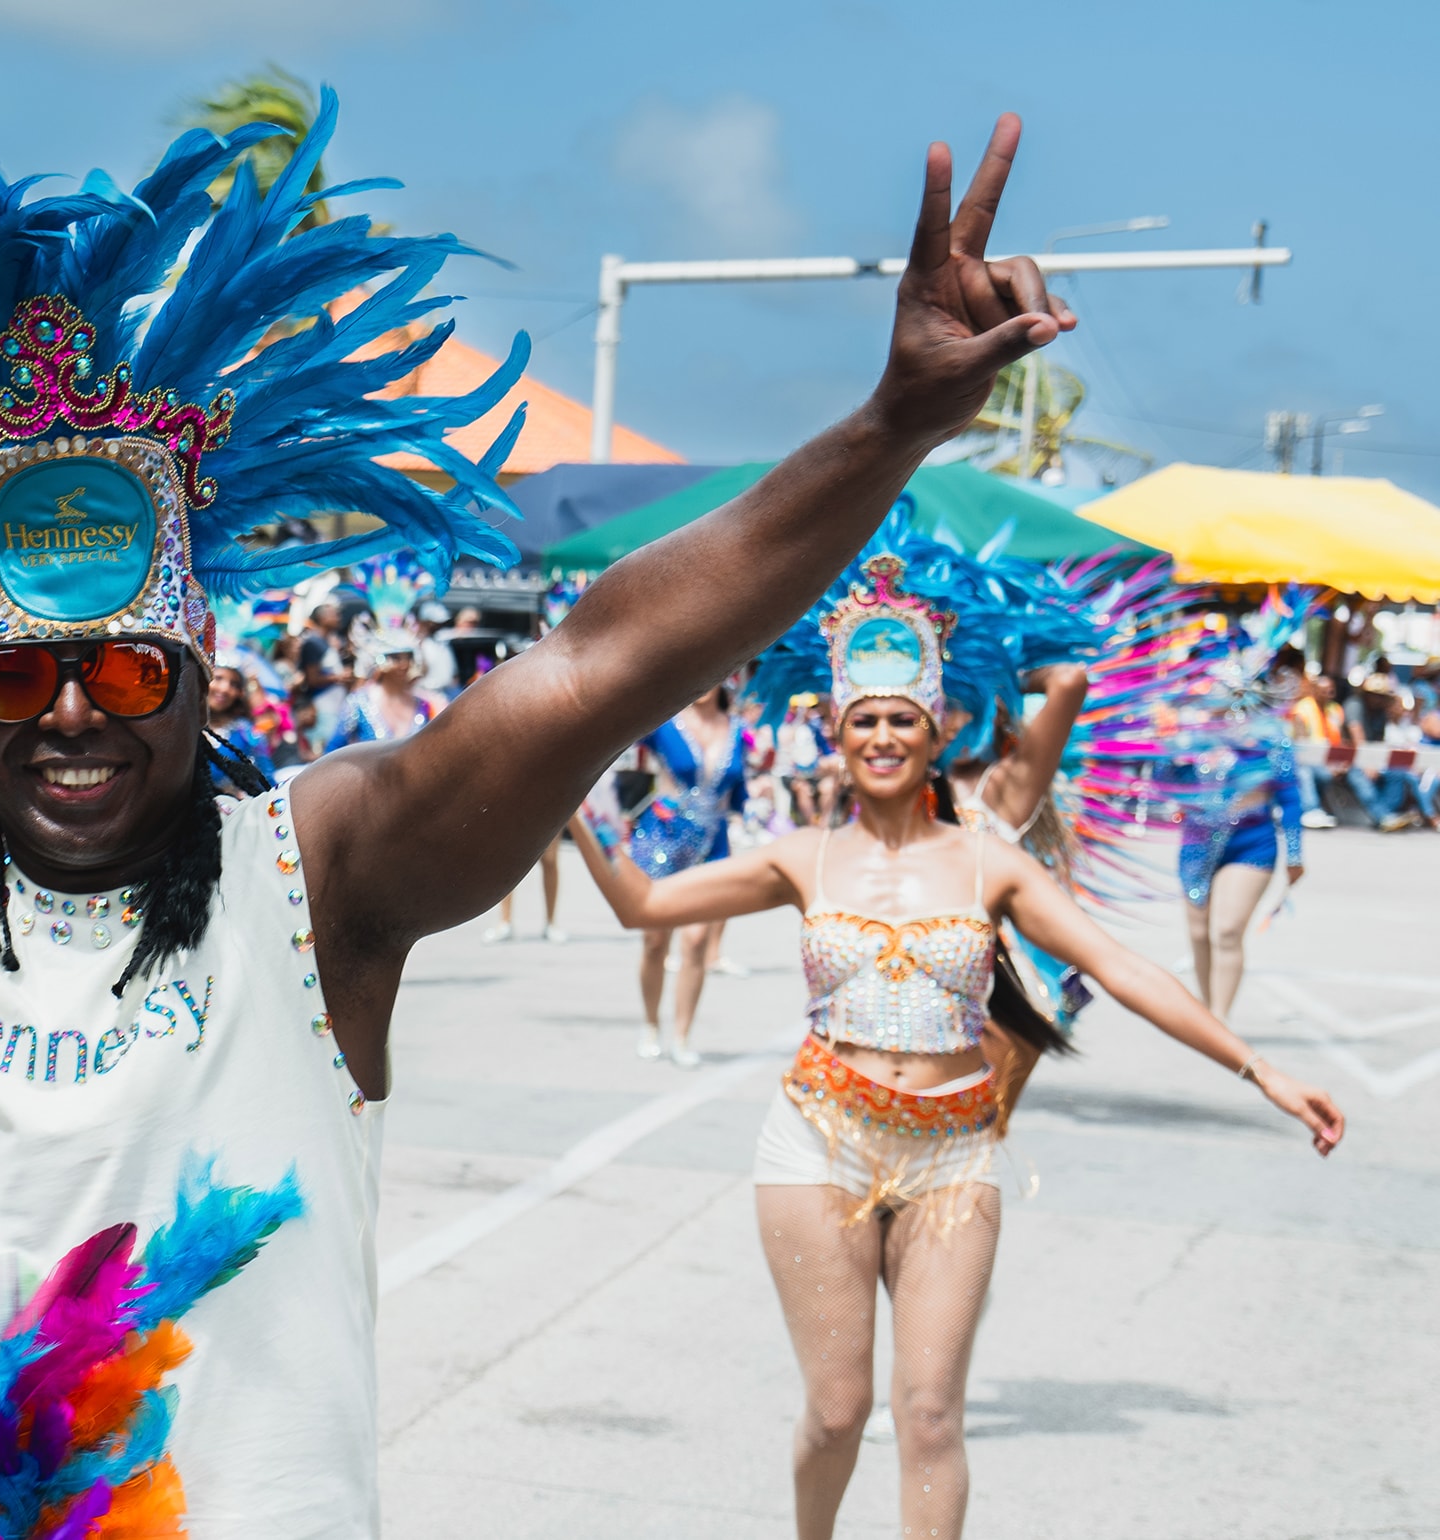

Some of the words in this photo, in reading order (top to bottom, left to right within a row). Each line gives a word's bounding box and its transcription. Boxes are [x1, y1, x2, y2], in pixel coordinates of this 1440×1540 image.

[3, 522, 139, 551] Hennessy
[20, 552, 56, 568] VERY
[59, 549, 122, 566] SPECIAL
